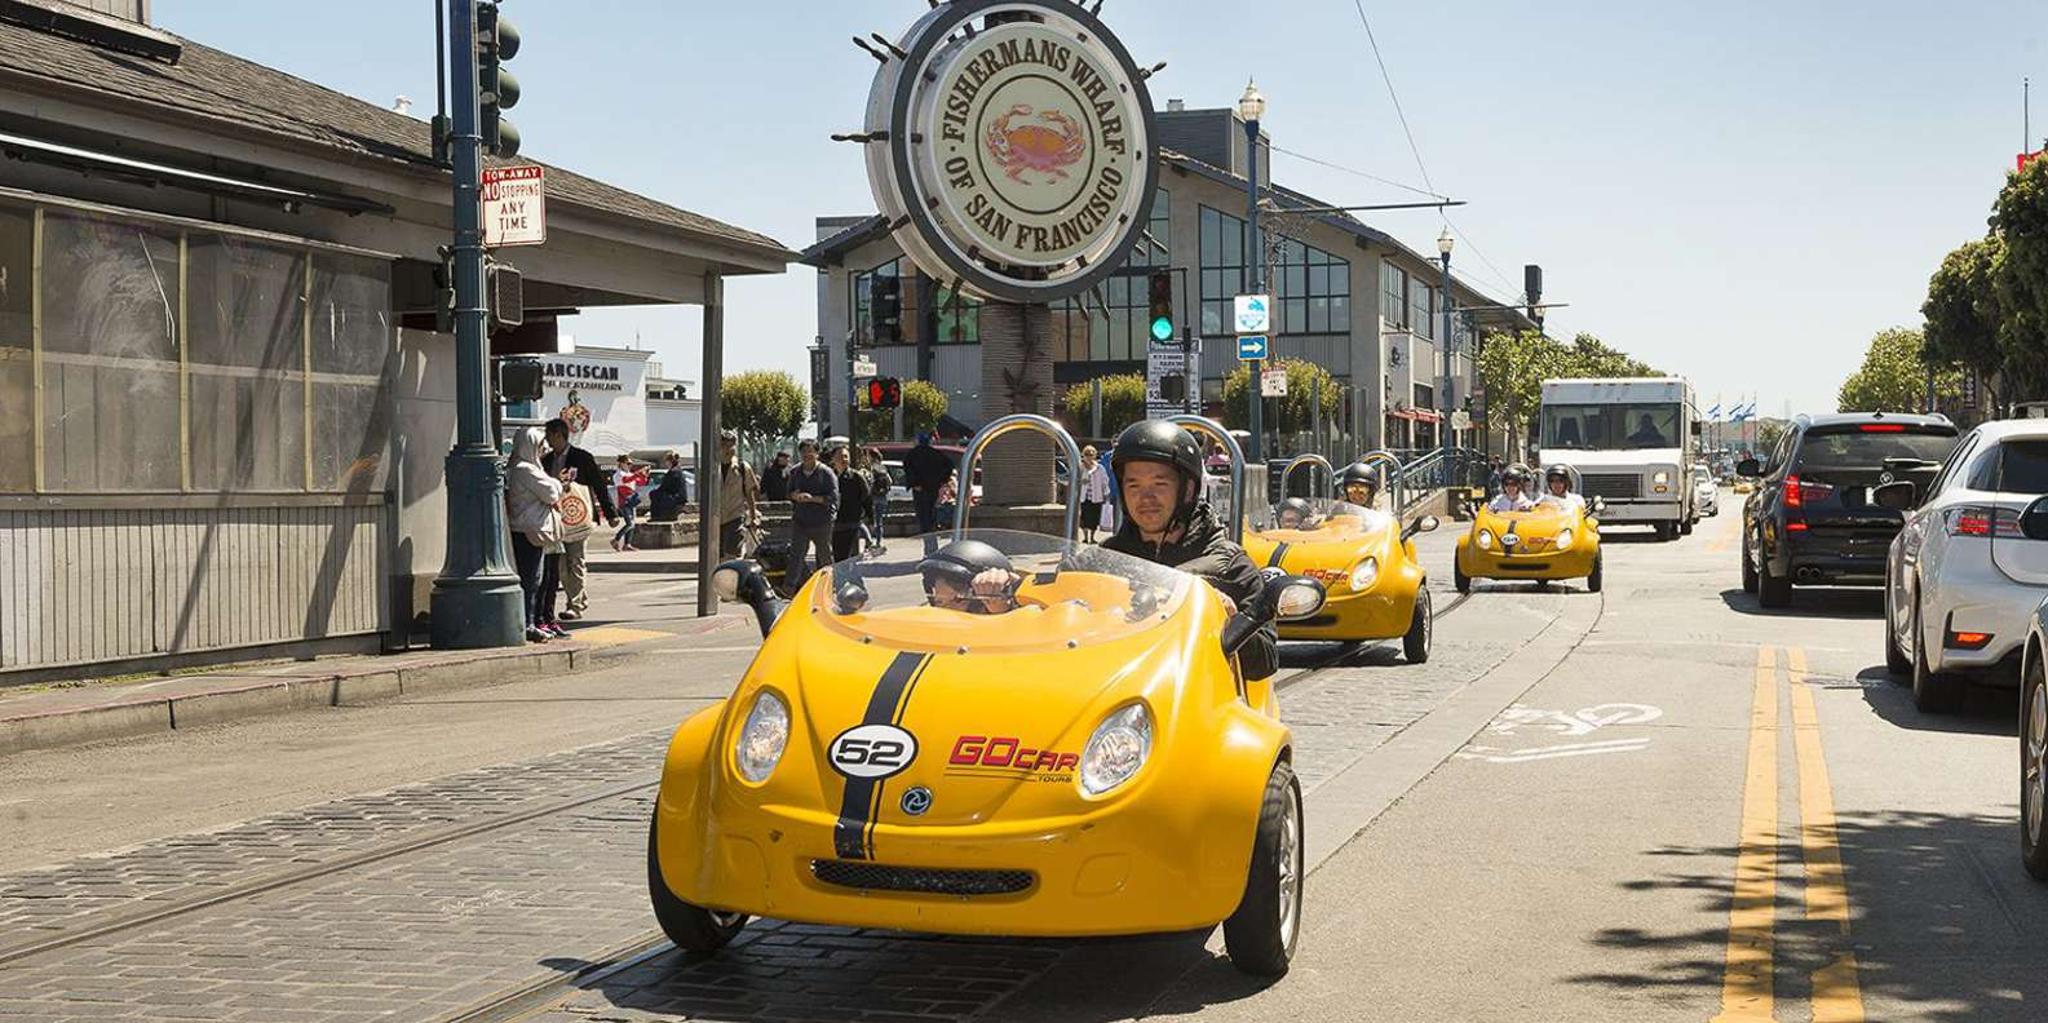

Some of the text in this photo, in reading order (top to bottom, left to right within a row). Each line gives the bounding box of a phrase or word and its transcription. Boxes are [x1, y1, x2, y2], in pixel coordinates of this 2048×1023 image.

[942, 38, 1126, 156] FISHERMANS WHARF
[485, 168, 538, 181] TOW-AWAY
[484, 182, 540, 200] NO STOPPING
[500, 201, 526, 215] ANY
[944, 157, 1123, 252] OF SAN FRANCISCO
[498, 216, 528, 231] TIME
[542, 363, 619, 380] ANCISCAN
[835, 738, 905, 767] 52
[1036, 774, 1073, 784] TOURS
